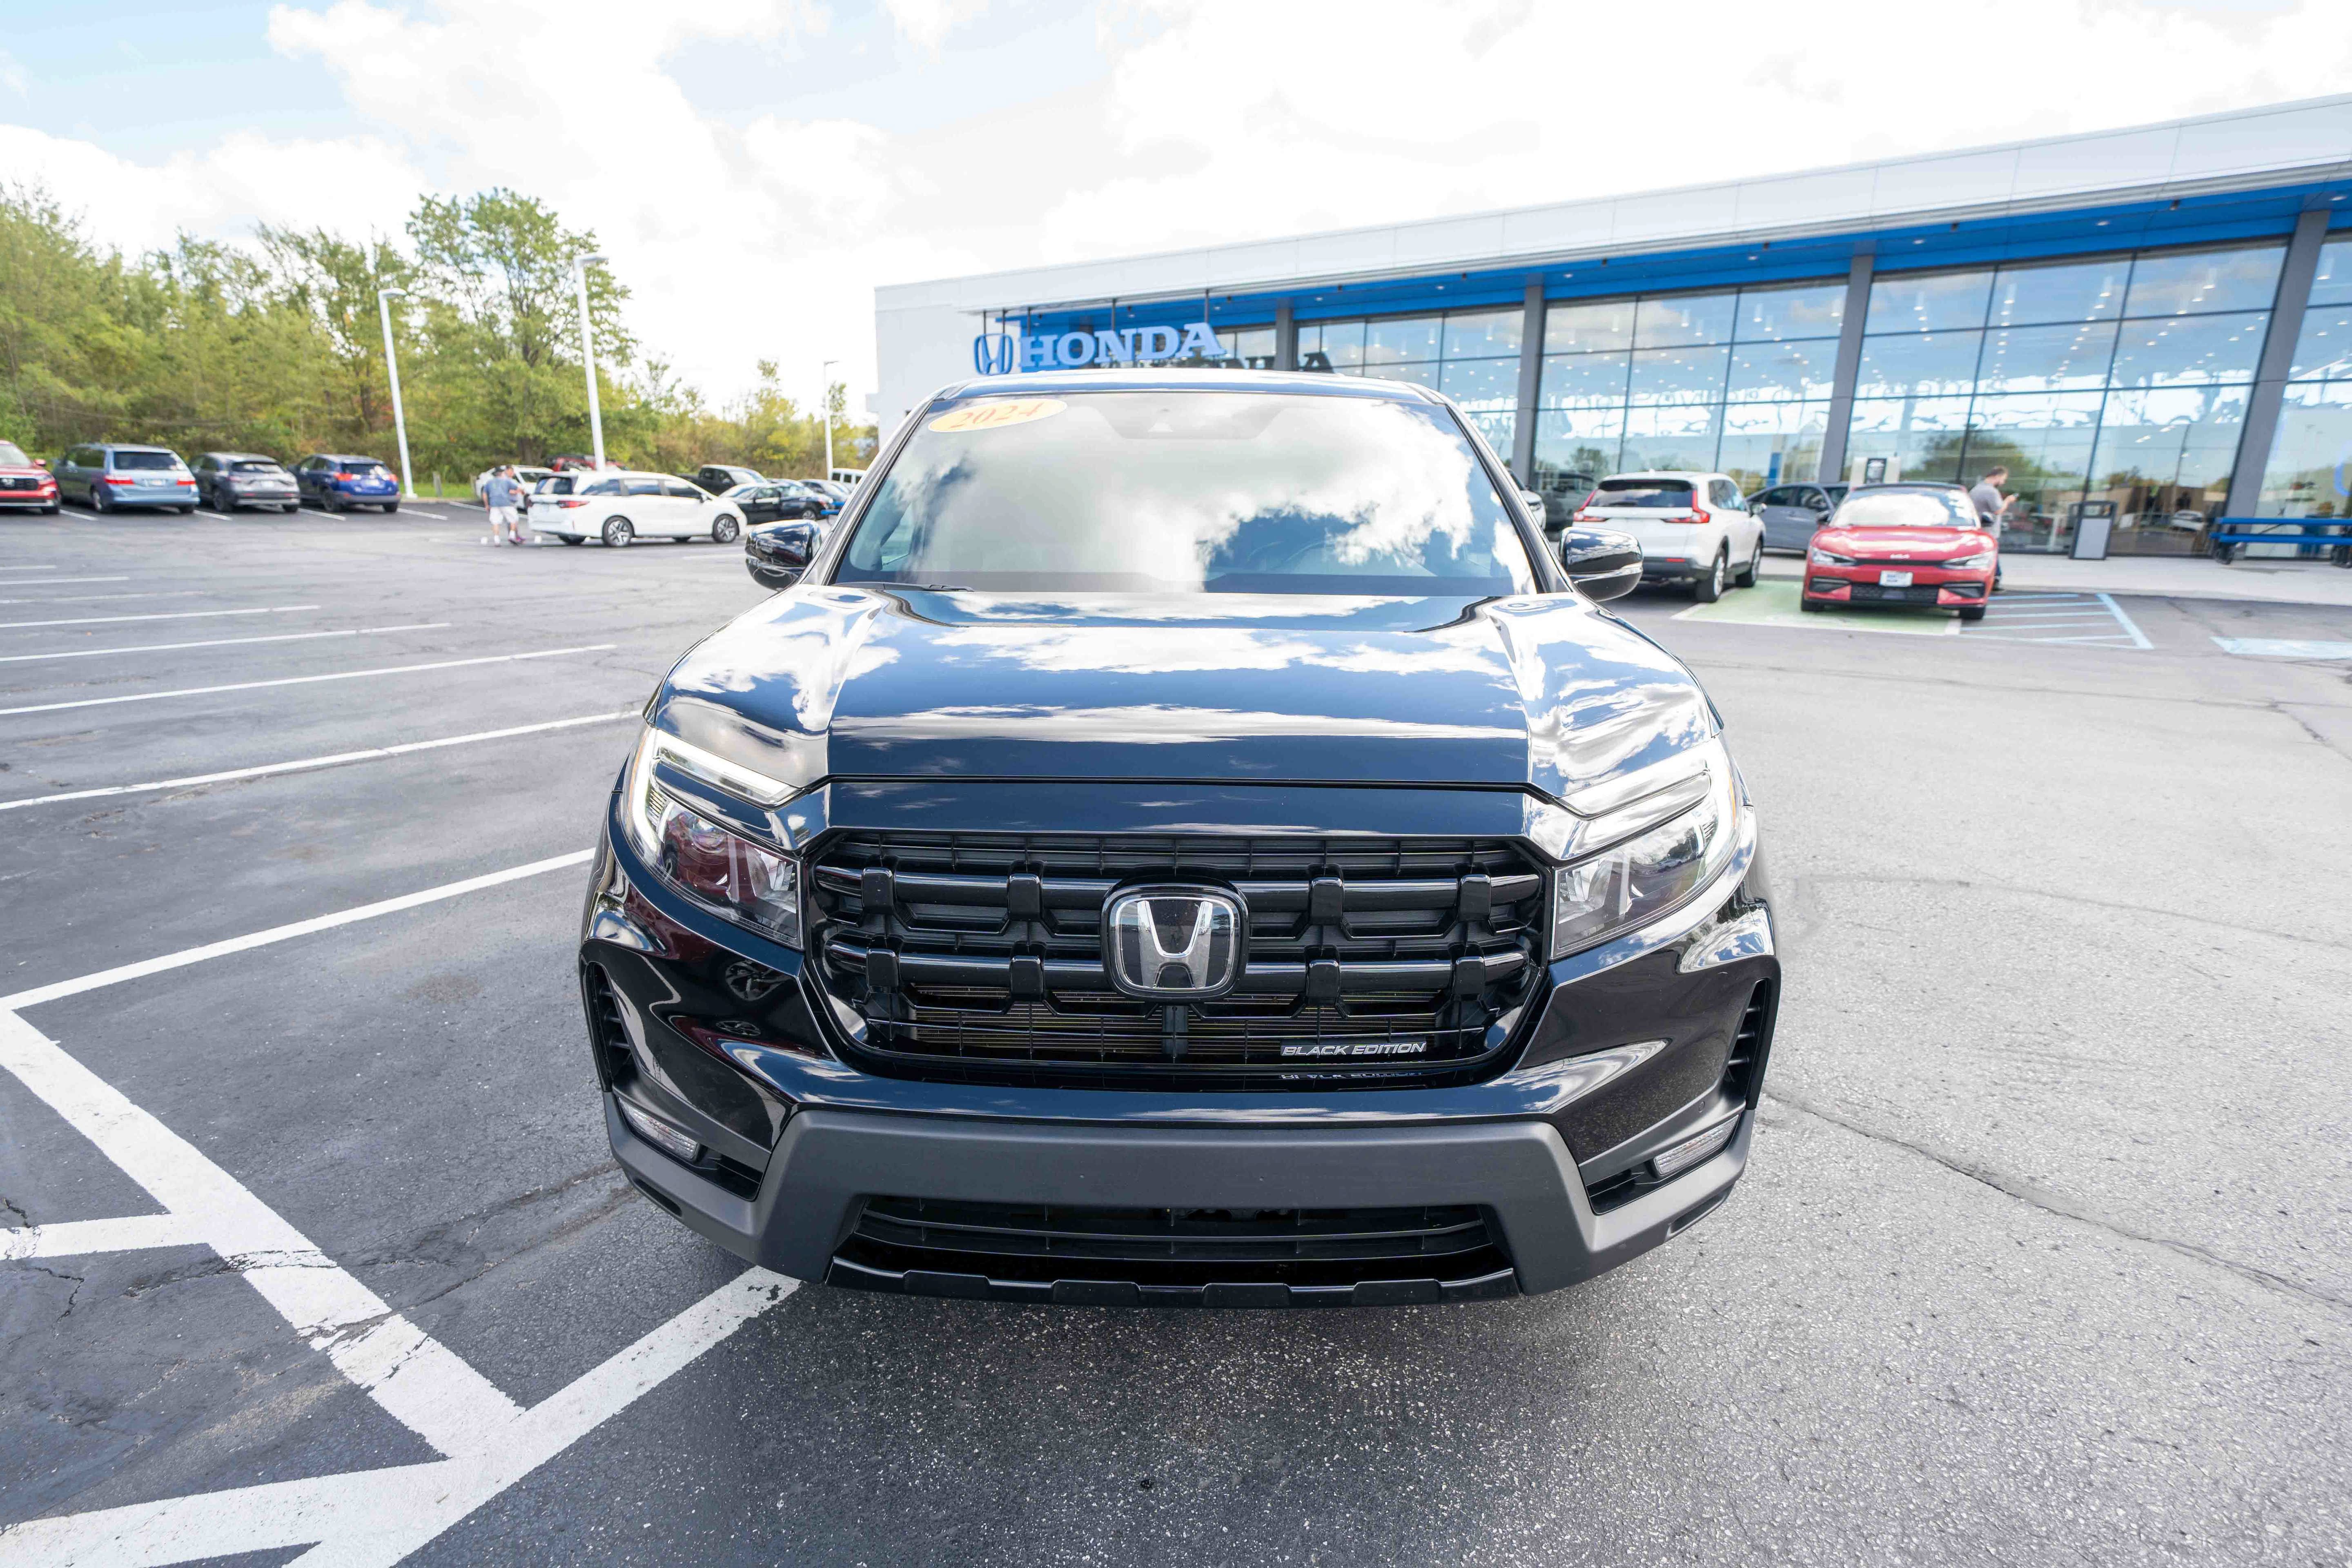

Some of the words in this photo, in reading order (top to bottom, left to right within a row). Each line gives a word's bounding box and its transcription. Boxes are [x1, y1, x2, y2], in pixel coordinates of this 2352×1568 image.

[1019, 323, 1226, 368] HONDA
[949, 402, 1044, 429] 2024
[1282, 1046, 1349, 1056] BLACK
[1352, 1043, 1426, 1054] EDITION
